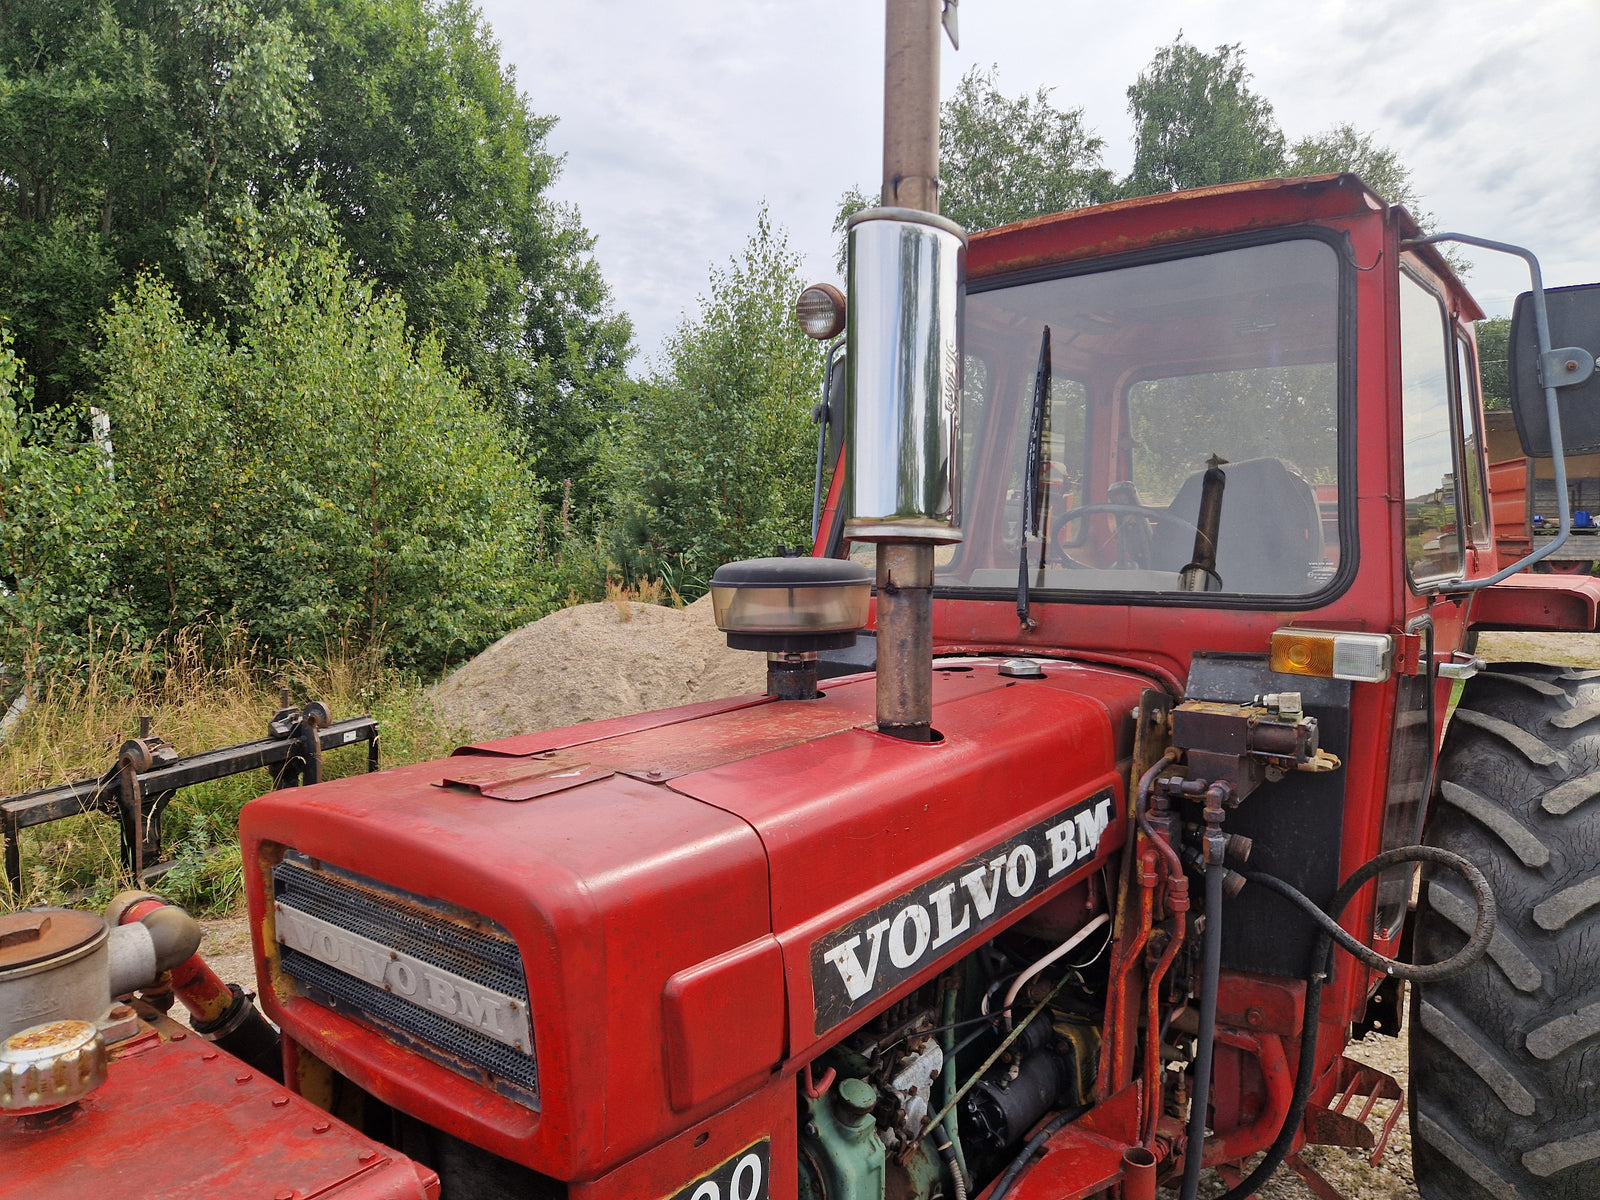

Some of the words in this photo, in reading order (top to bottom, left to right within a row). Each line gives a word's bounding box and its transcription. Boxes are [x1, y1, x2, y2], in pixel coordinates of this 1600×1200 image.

[288, 914, 418, 996] VOLVO
[424, 972, 504, 1034] BM
[824, 844, 1037, 1001] VOLVO
[1045, 798, 1111, 878] BM
